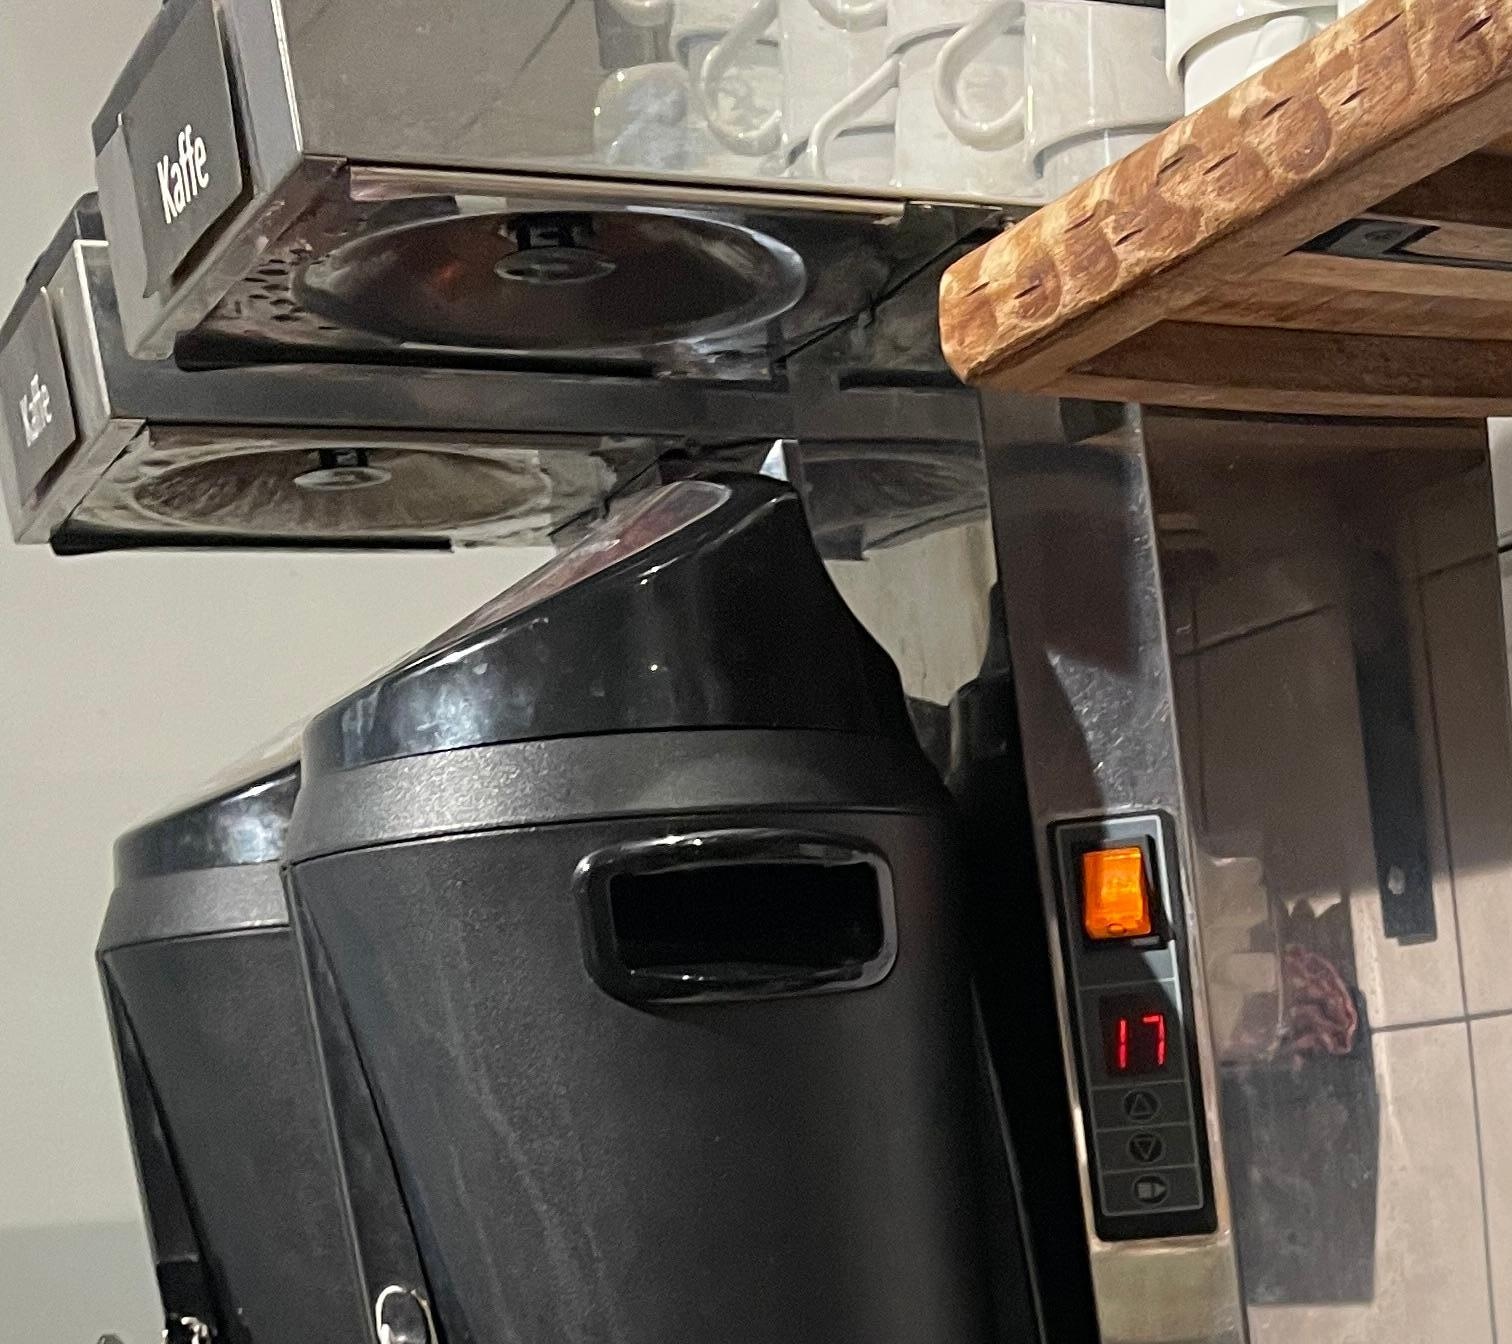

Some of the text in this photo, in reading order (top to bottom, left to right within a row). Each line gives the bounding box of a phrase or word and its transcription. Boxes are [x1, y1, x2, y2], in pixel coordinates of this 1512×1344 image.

[157, 124, 210, 224] Kaffe
[20, 374, 52, 446] Kaffe
[1117, 1012, 1166, 1069] 17
